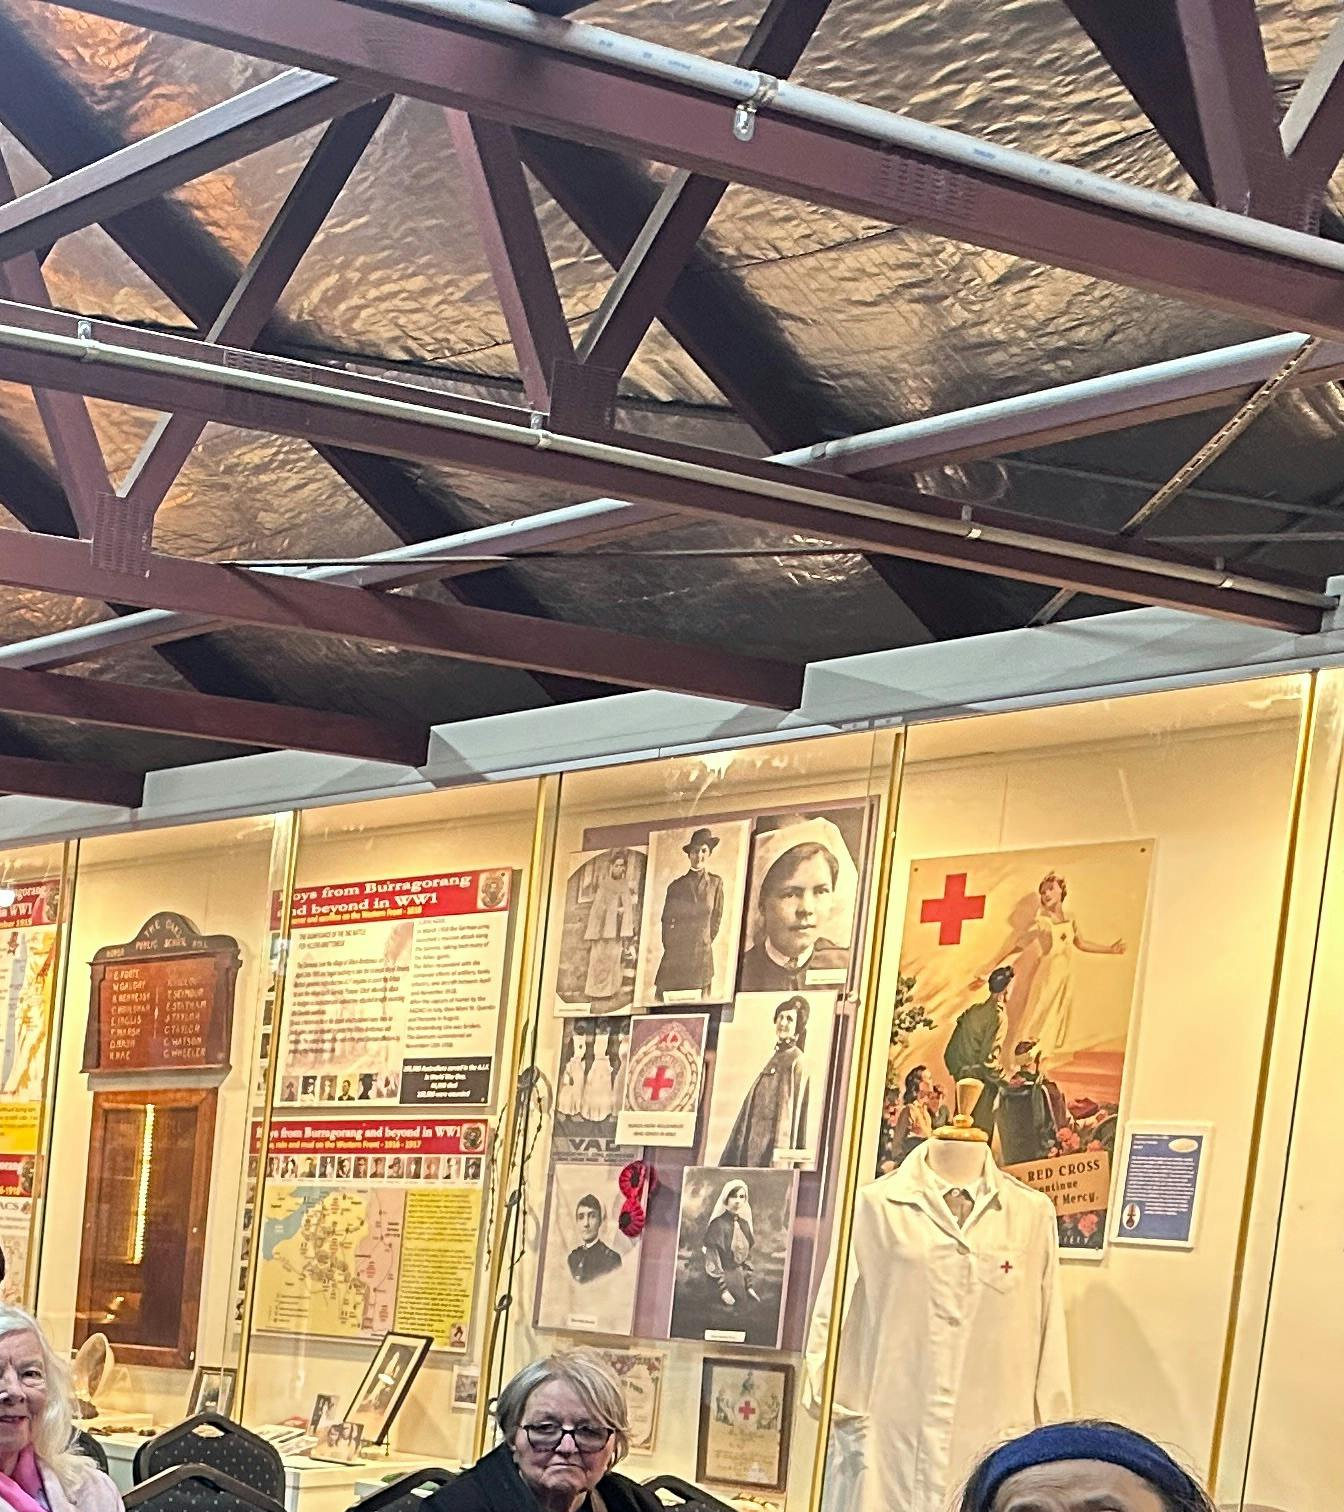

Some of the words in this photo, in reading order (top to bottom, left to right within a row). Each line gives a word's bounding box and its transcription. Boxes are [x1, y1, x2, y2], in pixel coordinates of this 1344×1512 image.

[322, 886, 360, 899] from
[364, 875, 472, 894] Burragorang
[312, 897, 370, 914] beyond
[373, 897, 390, 909] in
[280, 1126, 303, 1138] from
[304, 1126, 364, 1140] Burragorang
[364, 1126, 382, 1138] and
[385, 1126, 420, 1140] beyond
[422, 1126, 432, 1138] in
[1028, 1168, 1053, 1182] RED
[1058, 1160, 1100, 1177] CROSS
[1063, 1192, 1100, 1206] Mercy.
